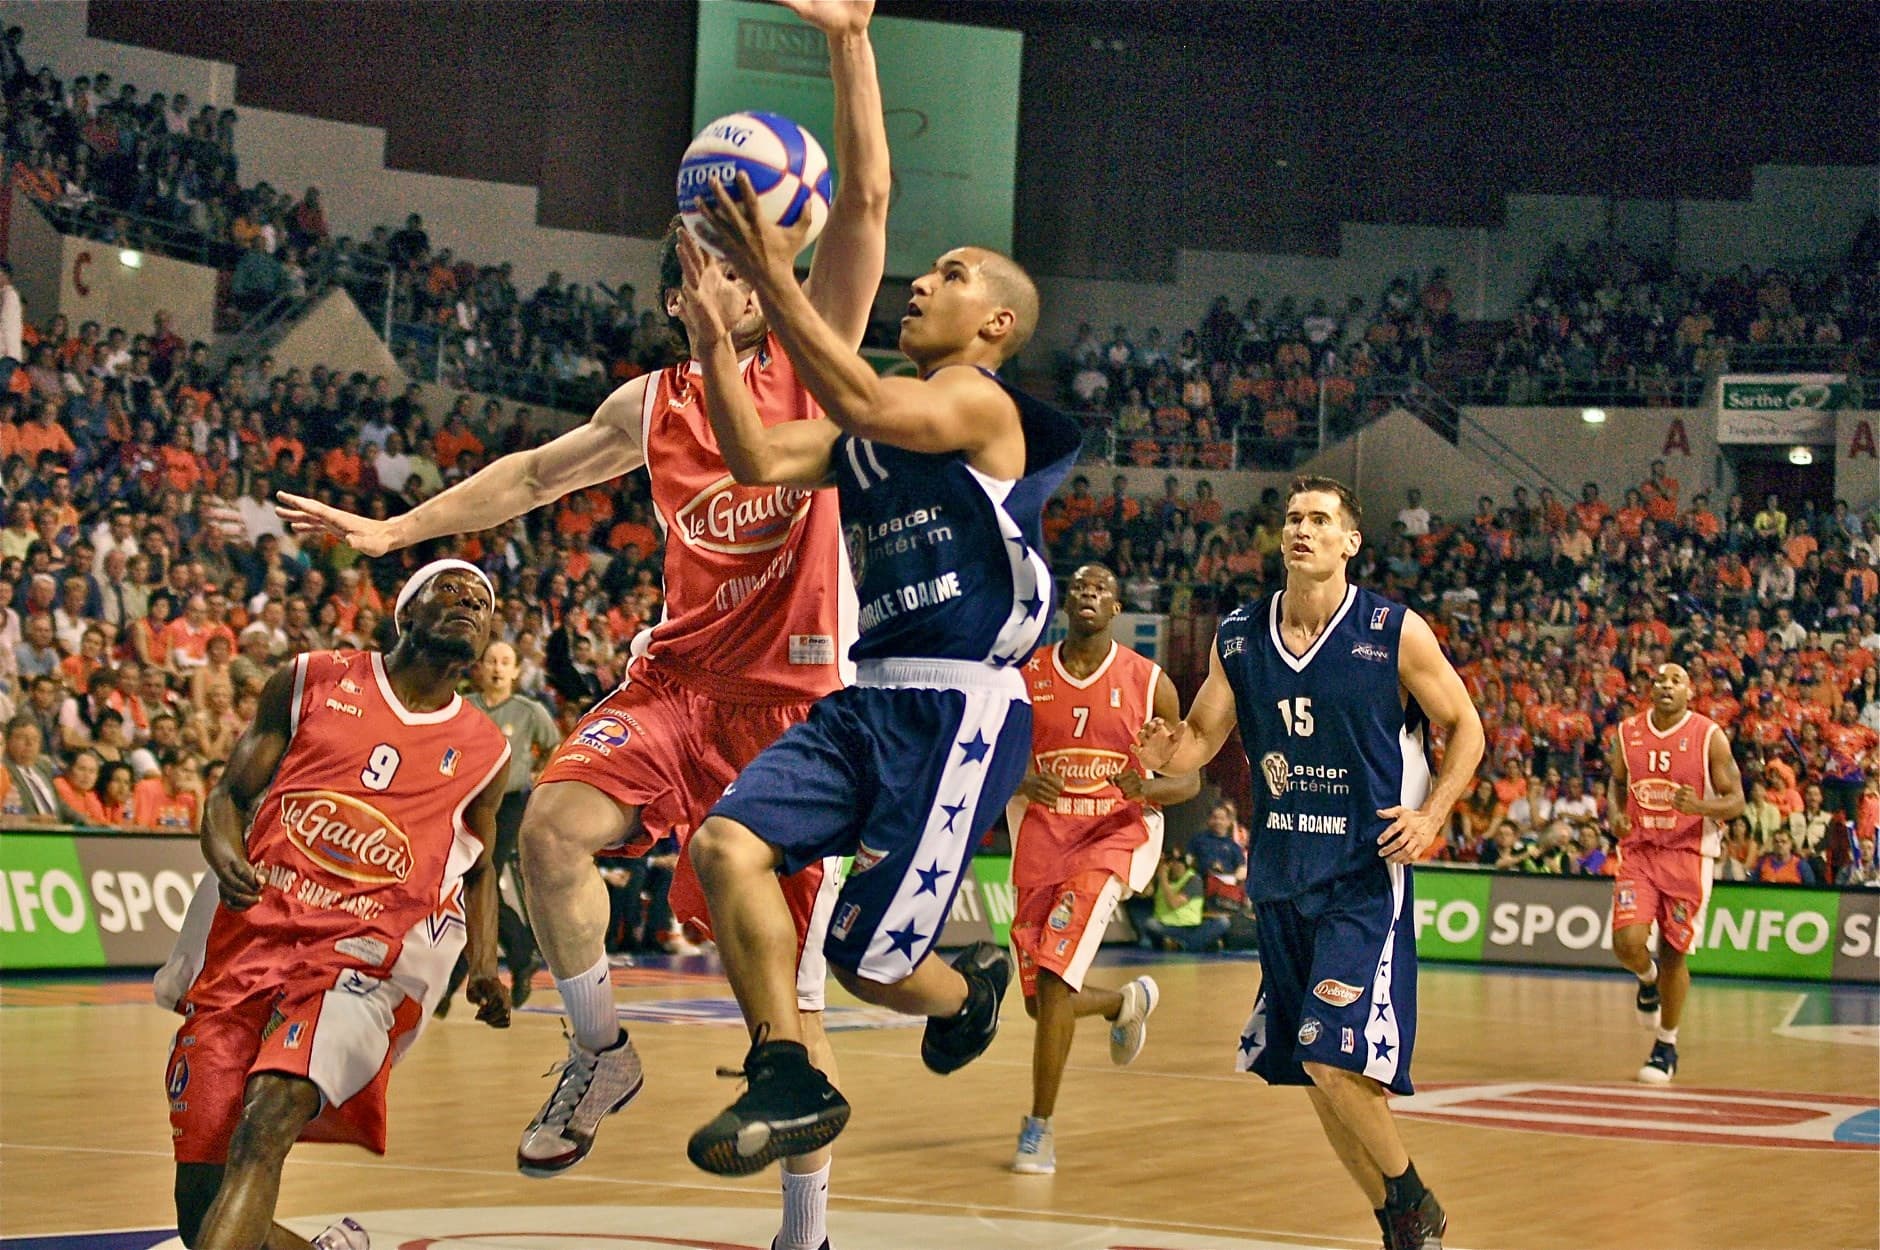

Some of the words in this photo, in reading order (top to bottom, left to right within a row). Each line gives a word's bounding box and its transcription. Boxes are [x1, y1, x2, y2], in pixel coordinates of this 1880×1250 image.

[73, 252, 92, 296] C
[1662, 418, 1691, 456] A
[1849, 420, 1877, 459] A
[1072, 707, 1090, 738] 7
[1277, 697, 1314, 737] 15
[360, 743, 401, 791] 9
[1051, 756, 1122, 780] Gaulois
[1648, 751, 1671, 773] 15
[296, 799, 407, 879] Gaulois
[1298, 813, 1348, 836] ROANNE
[91, 869, 206, 934] SPO
